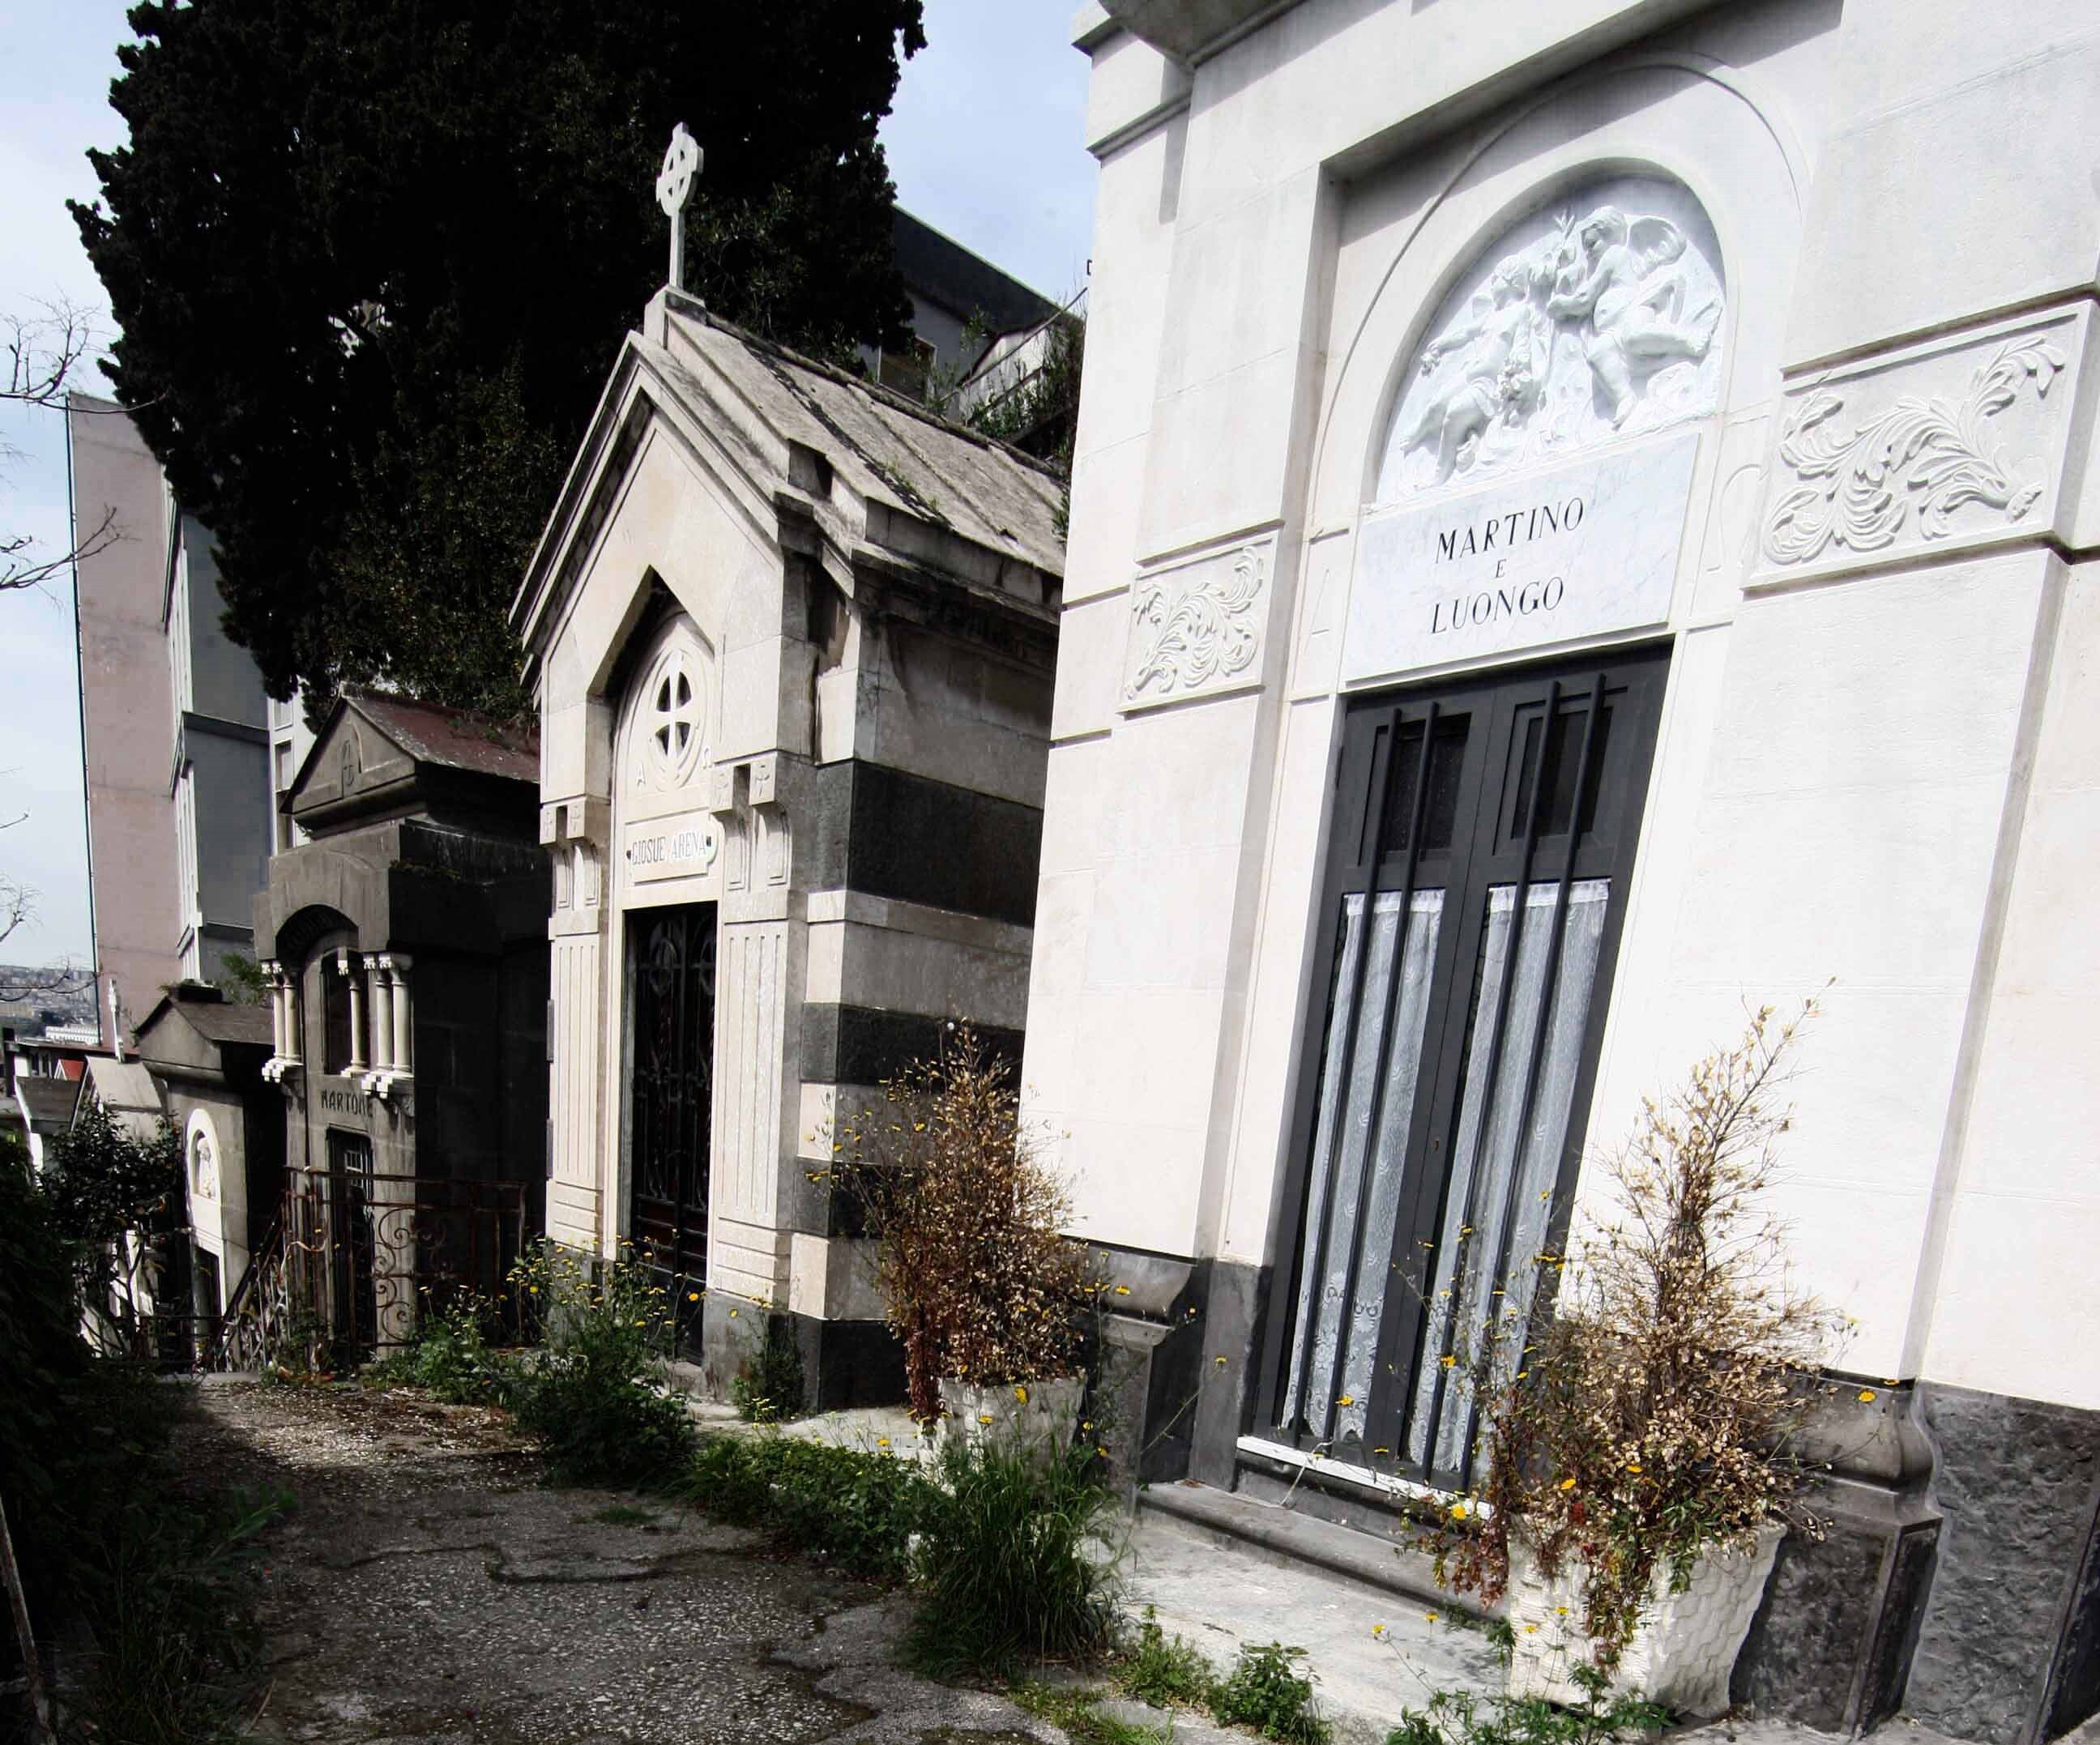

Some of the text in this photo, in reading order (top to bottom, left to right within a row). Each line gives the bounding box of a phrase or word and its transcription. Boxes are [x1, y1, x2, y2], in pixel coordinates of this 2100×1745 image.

[1435, 497, 1584, 565] MARTINO
[1494, 558, 1507, 578] E
[1431, 576, 1564, 634] LUONGO
[671, 831, 706, 859] ARENA
